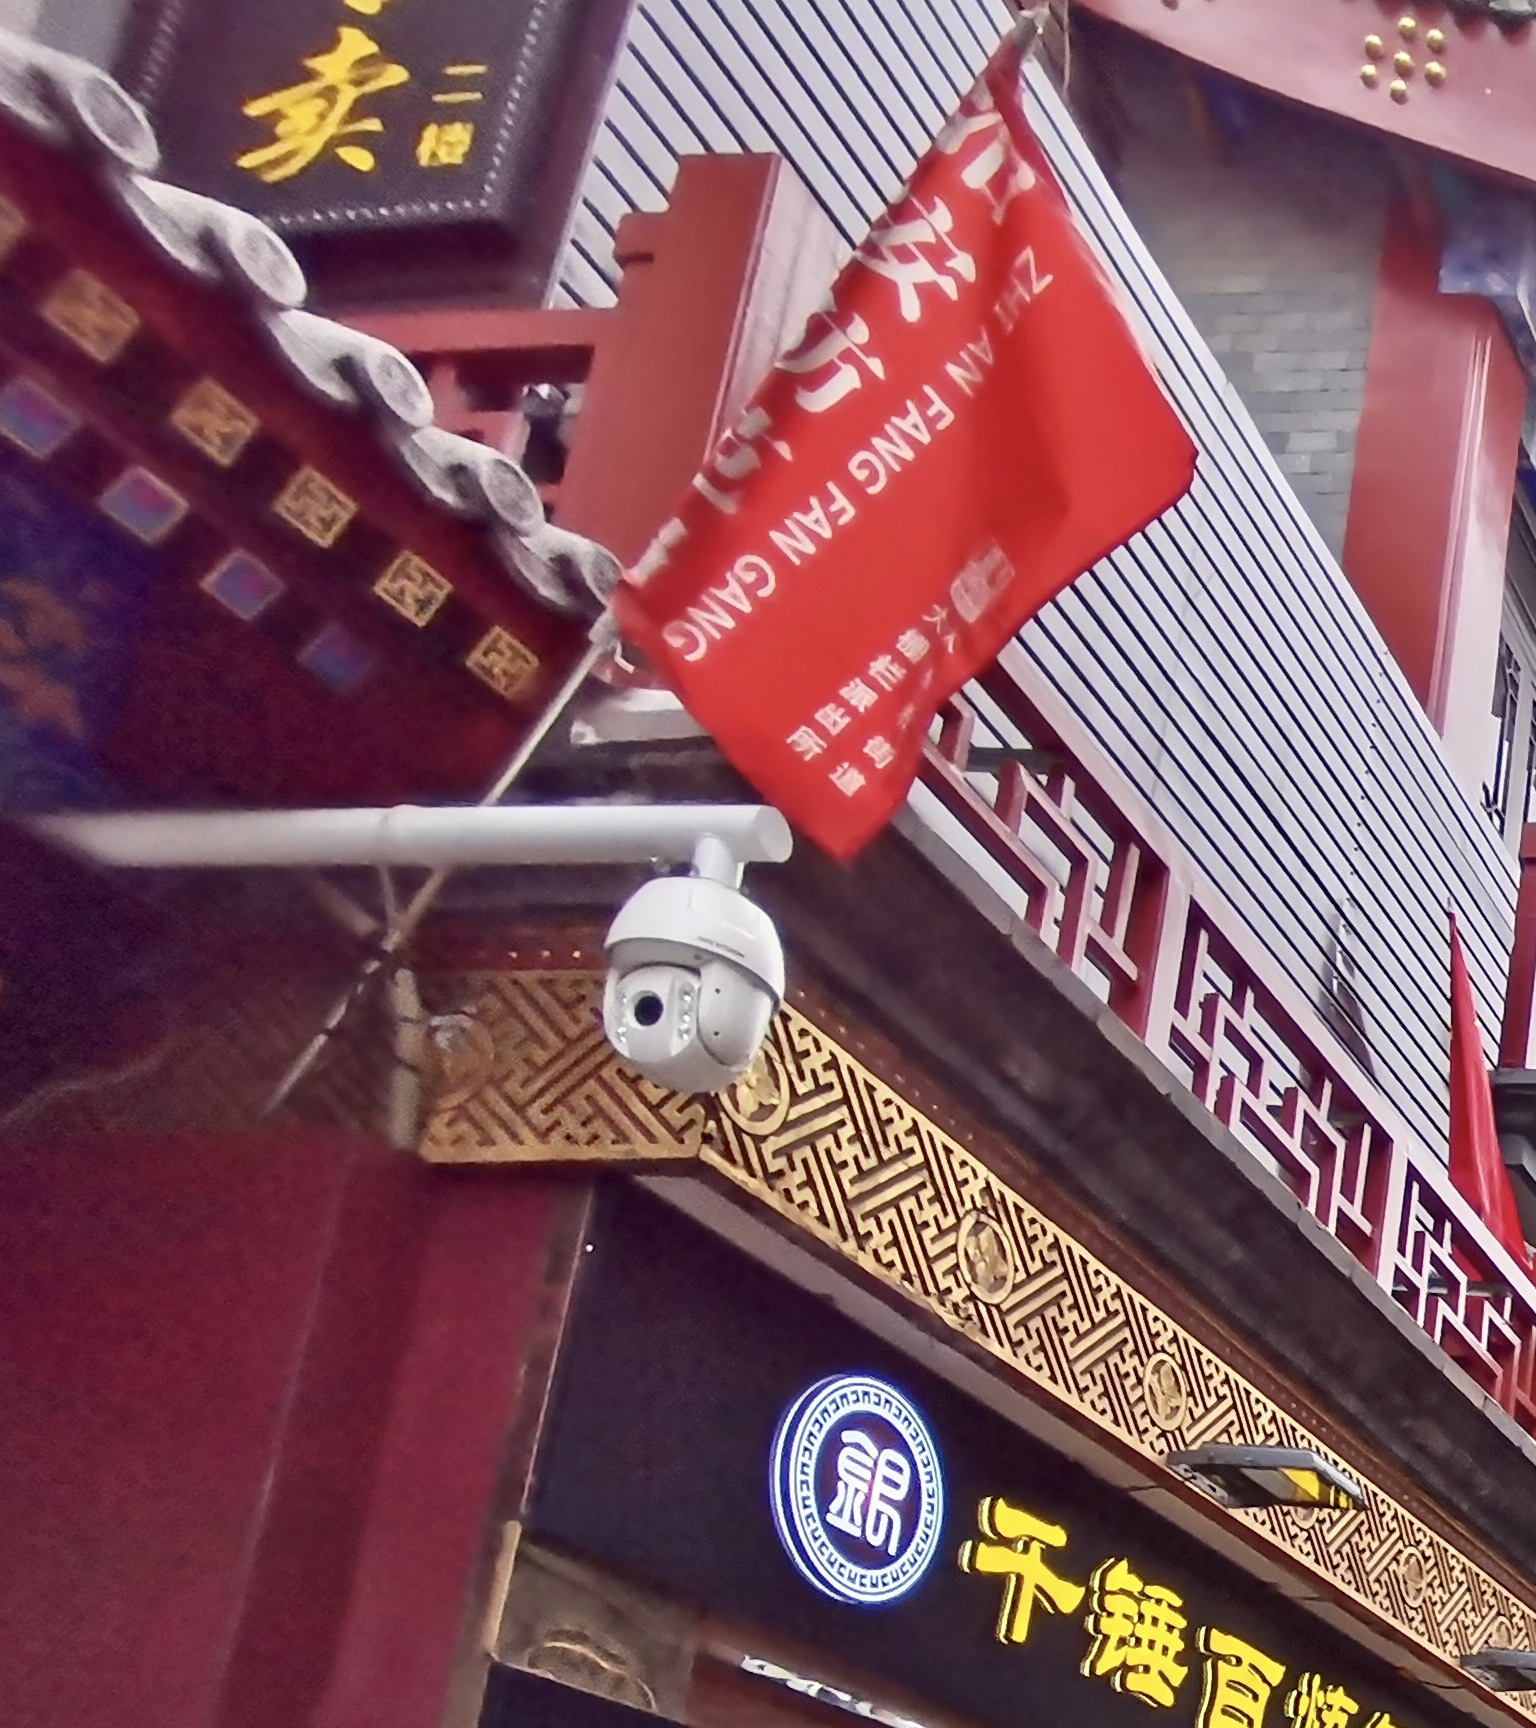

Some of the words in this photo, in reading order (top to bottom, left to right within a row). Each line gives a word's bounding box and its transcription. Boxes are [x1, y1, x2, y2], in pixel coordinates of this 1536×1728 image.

[993, 246, 1053, 334] ZHI
[944, 325, 996, 397] AN
[848, 383, 956, 496] FANG
[768, 481, 858, 567] FAN
[661, 554, 777, 663] GANG
